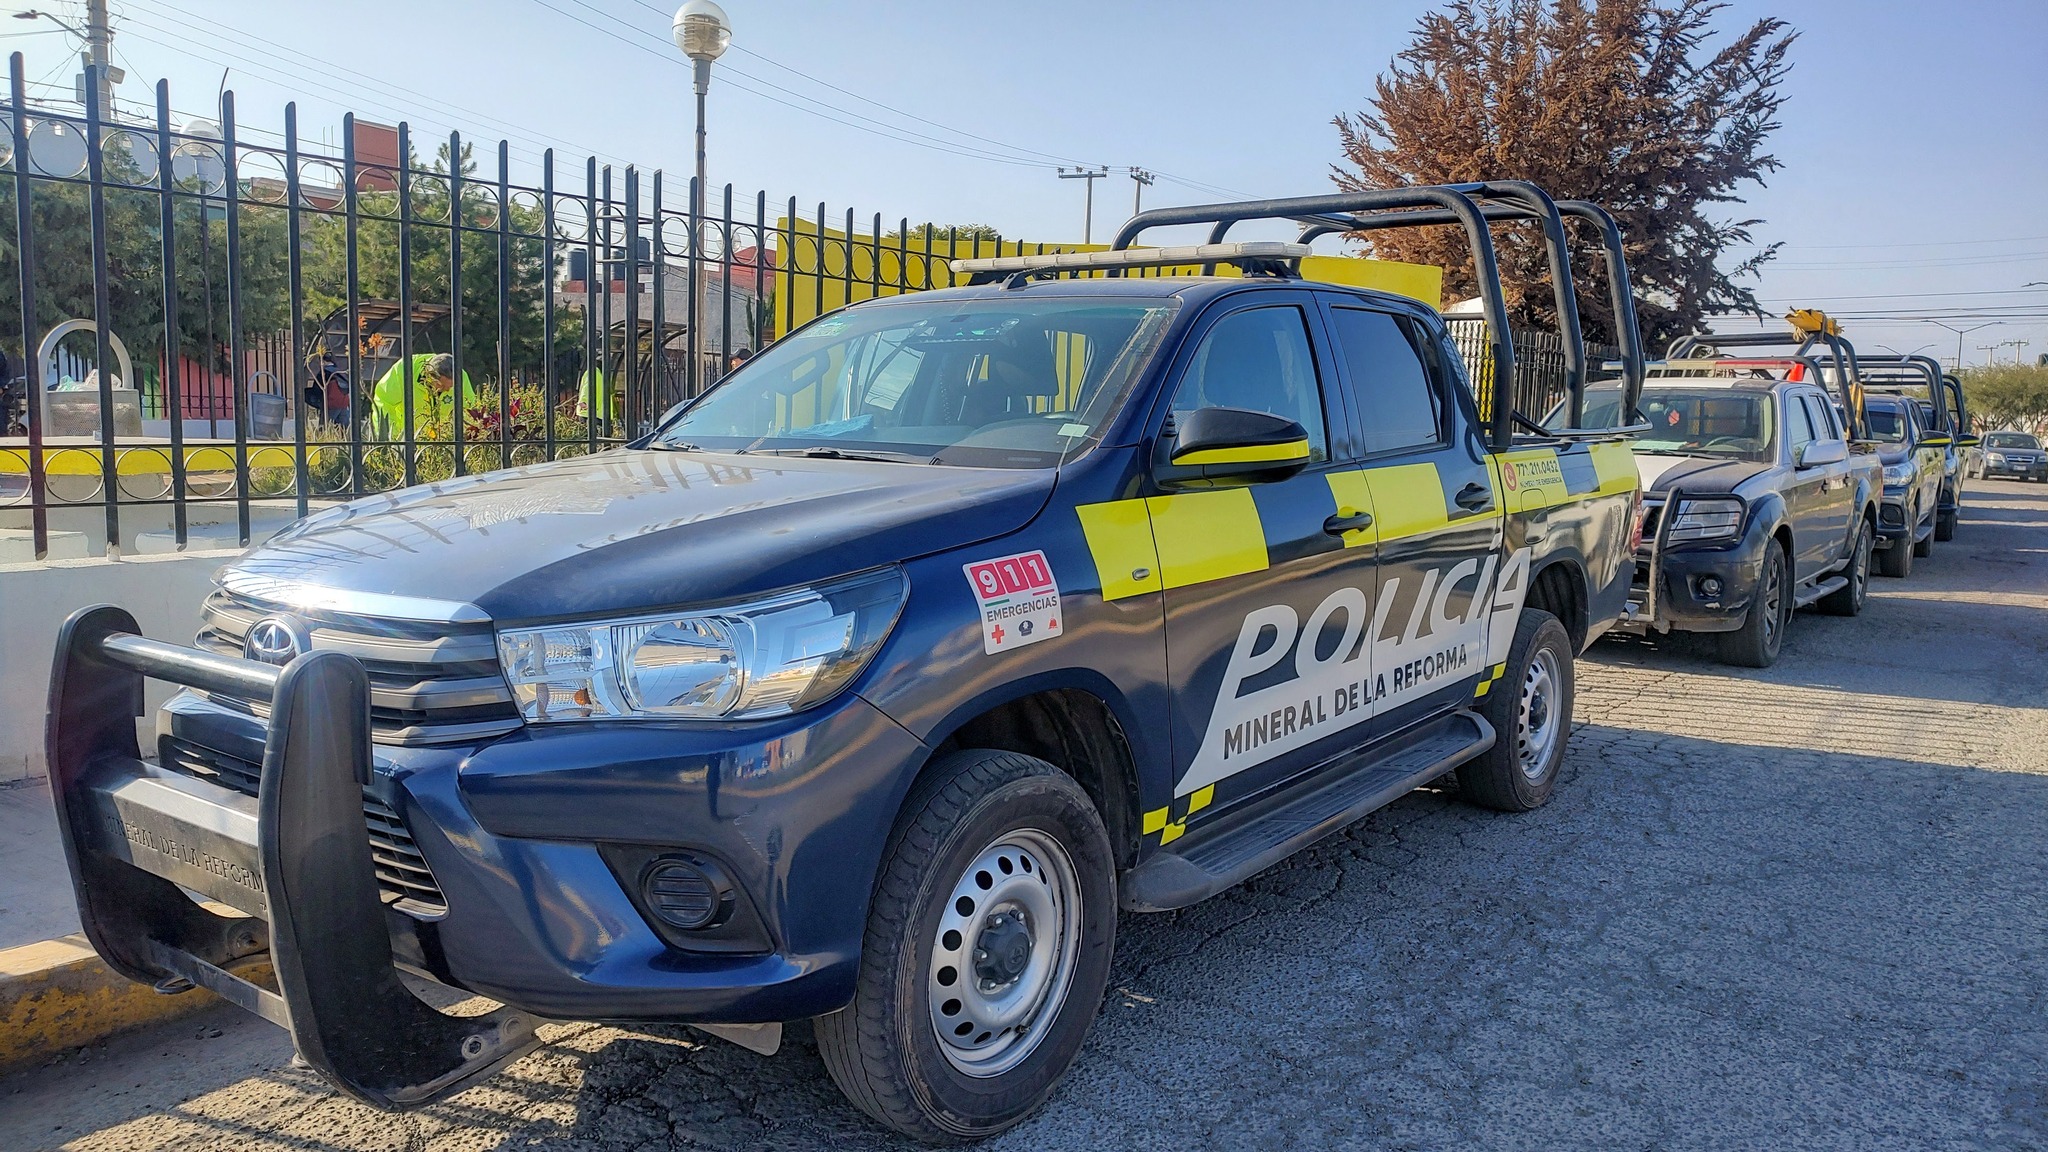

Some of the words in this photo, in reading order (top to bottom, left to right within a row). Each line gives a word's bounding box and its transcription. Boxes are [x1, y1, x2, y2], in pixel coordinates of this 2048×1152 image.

[978, 559, 1045, 594] 911
[986, 596, 1058, 623] EMERGENCIAS
[1223, 695, 1327, 761] MINERAL
[1334, 681, 1359, 717] DE
[1363, 672, 1388, 706] LA
[1393, 643, 1468, 695] REFORMA
[159, 835, 180, 860] DE
[181, 844, 201, 868] LA
[202, 851, 266, 893] REFORM
